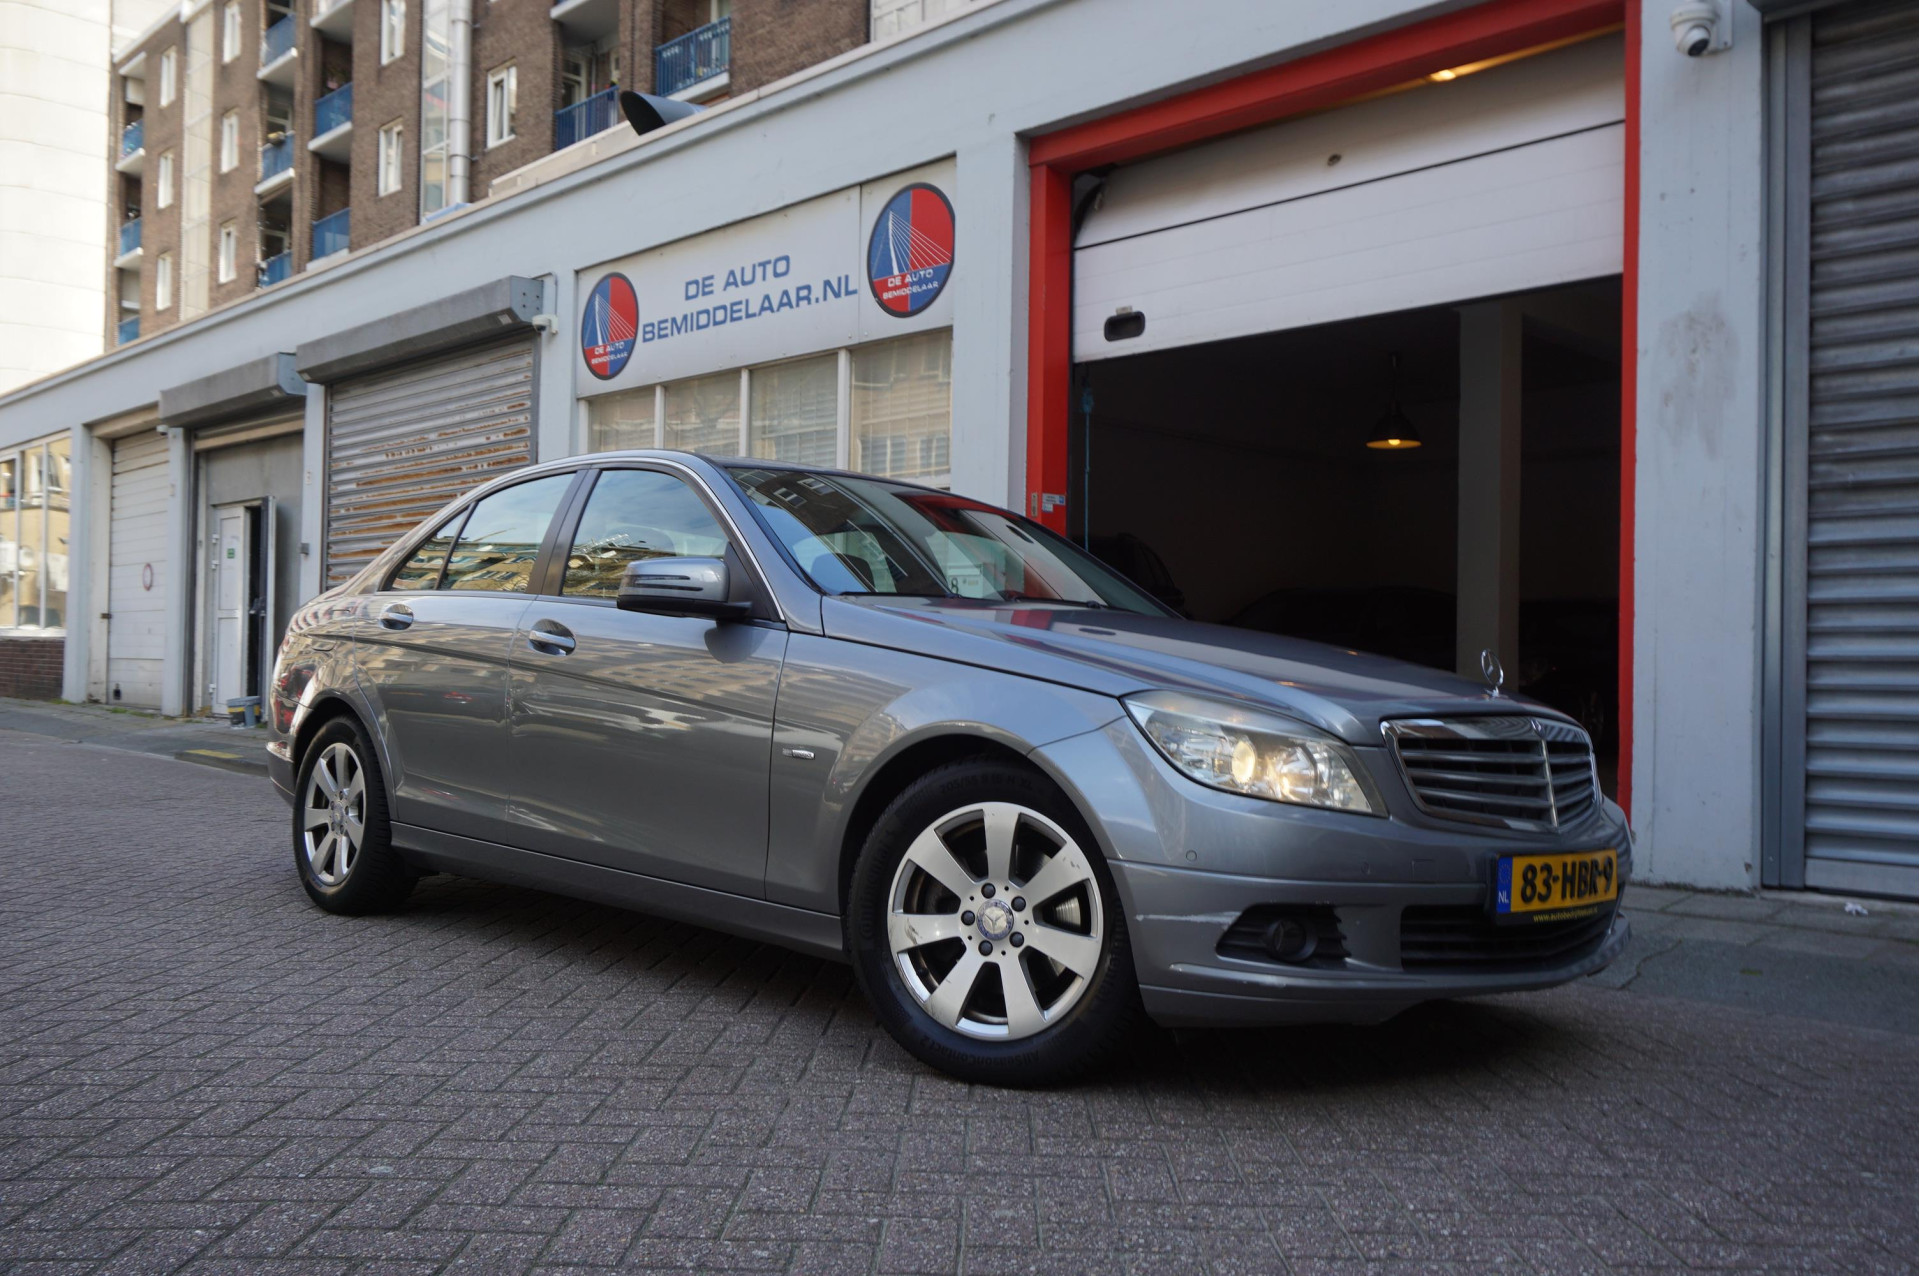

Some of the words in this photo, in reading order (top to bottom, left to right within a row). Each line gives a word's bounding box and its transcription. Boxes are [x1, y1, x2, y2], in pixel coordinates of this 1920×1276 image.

[685, 274, 715, 301] DE
[723, 254, 790, 291] AUTO
[887, 276, 903, 287] DE
[904, 268, 934, 284] AUTO
[882, 280, 939, 300] BEMIDDELAAR
[642, 274, 858, 343] BEMIDDELAAR.NL
[594, 346, 604, 355] DE
[605, 341, 625, 352] AUTO
[1521, 856, 1613, 904] 83-HBR-9
[1498, 890, 1510, 904] NL
